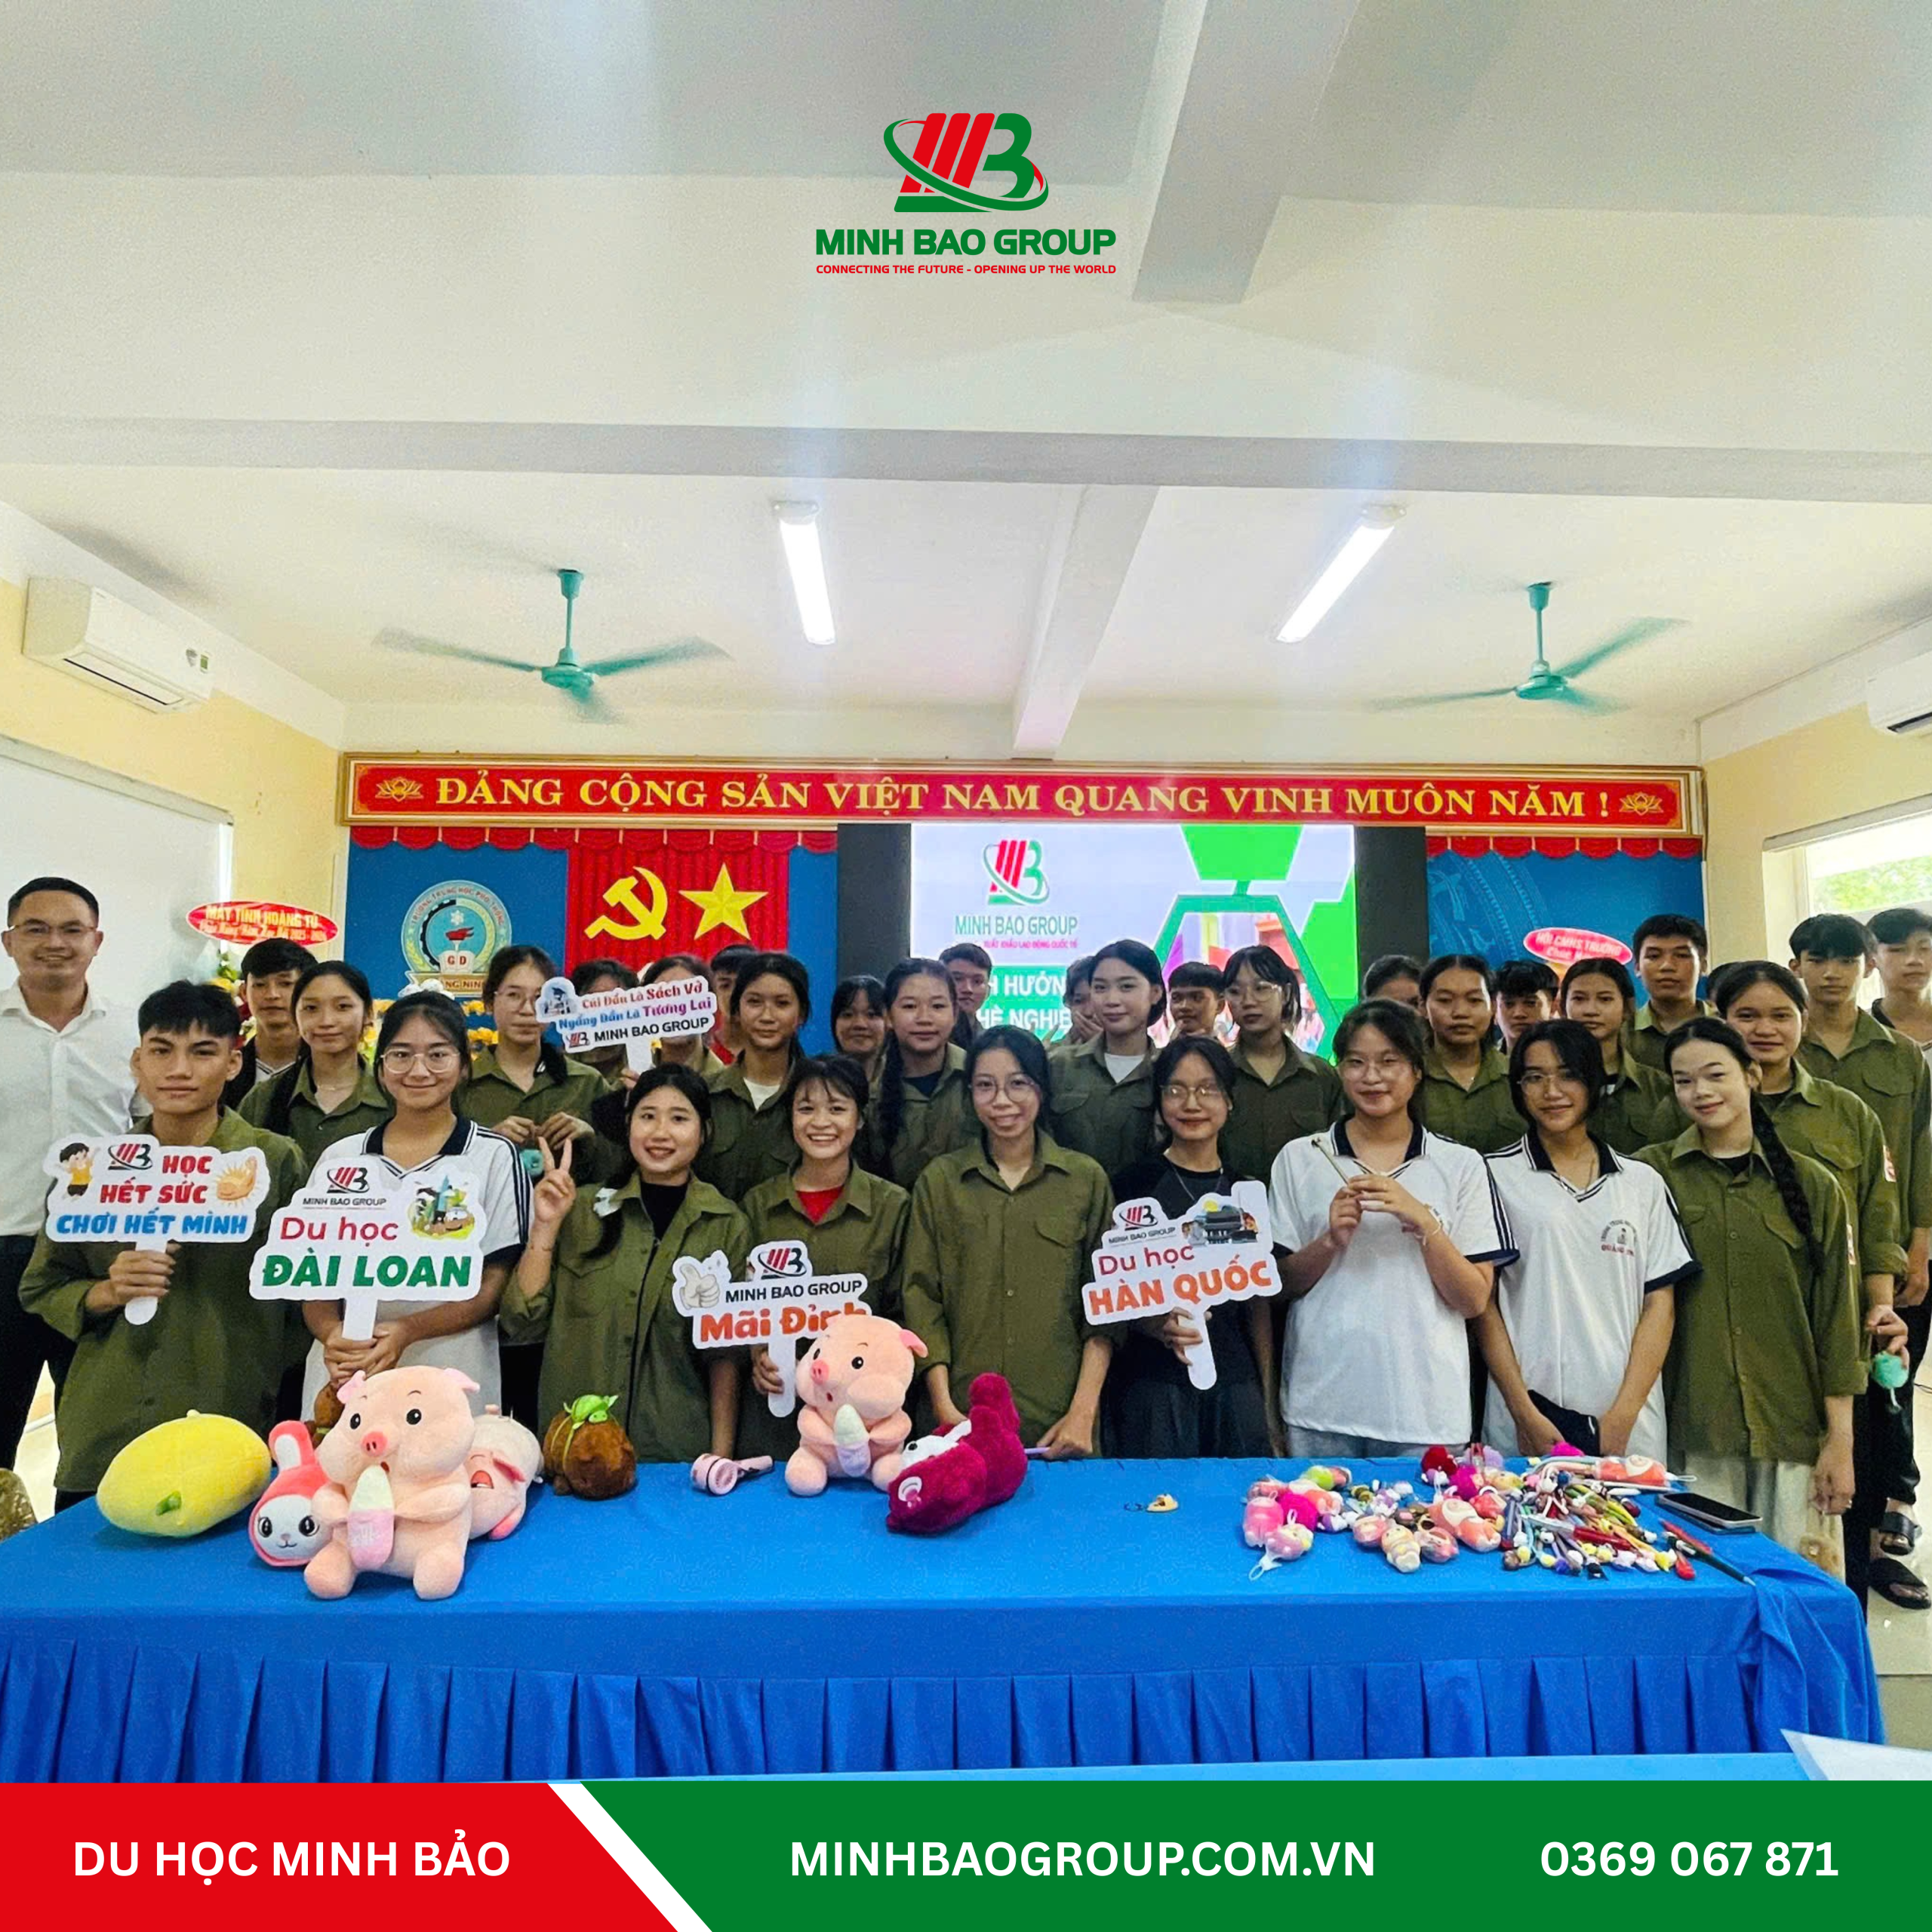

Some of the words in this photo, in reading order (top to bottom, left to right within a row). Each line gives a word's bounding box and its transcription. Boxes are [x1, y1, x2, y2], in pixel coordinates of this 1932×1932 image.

[436, 769, 563, 807] ĐẢNG
[580, 772, 708, 813] CỘNG
[721, 773, 811, 810] SẢN
[823, 777, 928, 817] VIỆT
[942, 783, 1039, 811] NAM
[1054, 785, 1209, 818] QUANG
[1220, 786, 1332, 814] VINH
[1345, 781, 1475, 816] MUÔN
[1489, 784, 1586, 817] NĂM
[1598, 789, 1609, 816] !
[955, 915, 991, 935] MINH
[995, 915, 1024, 935] BAO
[1028, 915, 1078, 935] GROUP
[447, 955, 455, 965] G
[460, 955, 467, 965] D
[583, 996, 601, 1009] Cúi
[630, 992, 644, 1002] Là
[646, 984, 681, 1000] Sách
[684, 980, 703, 995] Vở
[1004, 971, 1066, 996] HƯỚN
[626, 1009, 640, 1019] Là
[642, 1001, 687, 1017] Tương
[691, 997, 712, 1011] Lai
[594, 1029, 628, 1042] MINH
[632, 1024, 659, 1037] BAO
[662, 1017, 709, 1032] GROUP
[162, 1155, 213, 1177] HỌC
[100, 1177, 152, 1204] HẾT
[158, 1180, 209, 1204] SỨC
[303, 1198, 329, 1206] MINH
[330, 1198, 351, 1206] BAO
[352, 1198, 386, 1206] GROUP
[56, 1212, 118, 1235] CHƠI
[124, 1207, 176, 1235] HẾT
[182, 1210, 248, 1235] MÌNH
[280, 1217, 326, 1240] Du
[337, 1216, 398, 1247] học
[1130, 1232, 1147, 1241] BAO
[1148, 1226, 1176, 1238] GROUP
[262, 1247, 341, 1287] ĐÀI
[352, 1254, 472, 1287] LOAN
[1098, 1254, 1136, 1275] Du
[1144, 1245, 1195, 1269] học
[725, 1287, 767, 1303] MINH
[771, 1284, 804, 1299] BAO
[807, 1280, 862, 1296] GROUP
[1088, 1278, 1164, 1315] HÀN
[1173, 1254, 1272, 1305] QUỐC
[700, 1308, 771, 1342] Mãi
